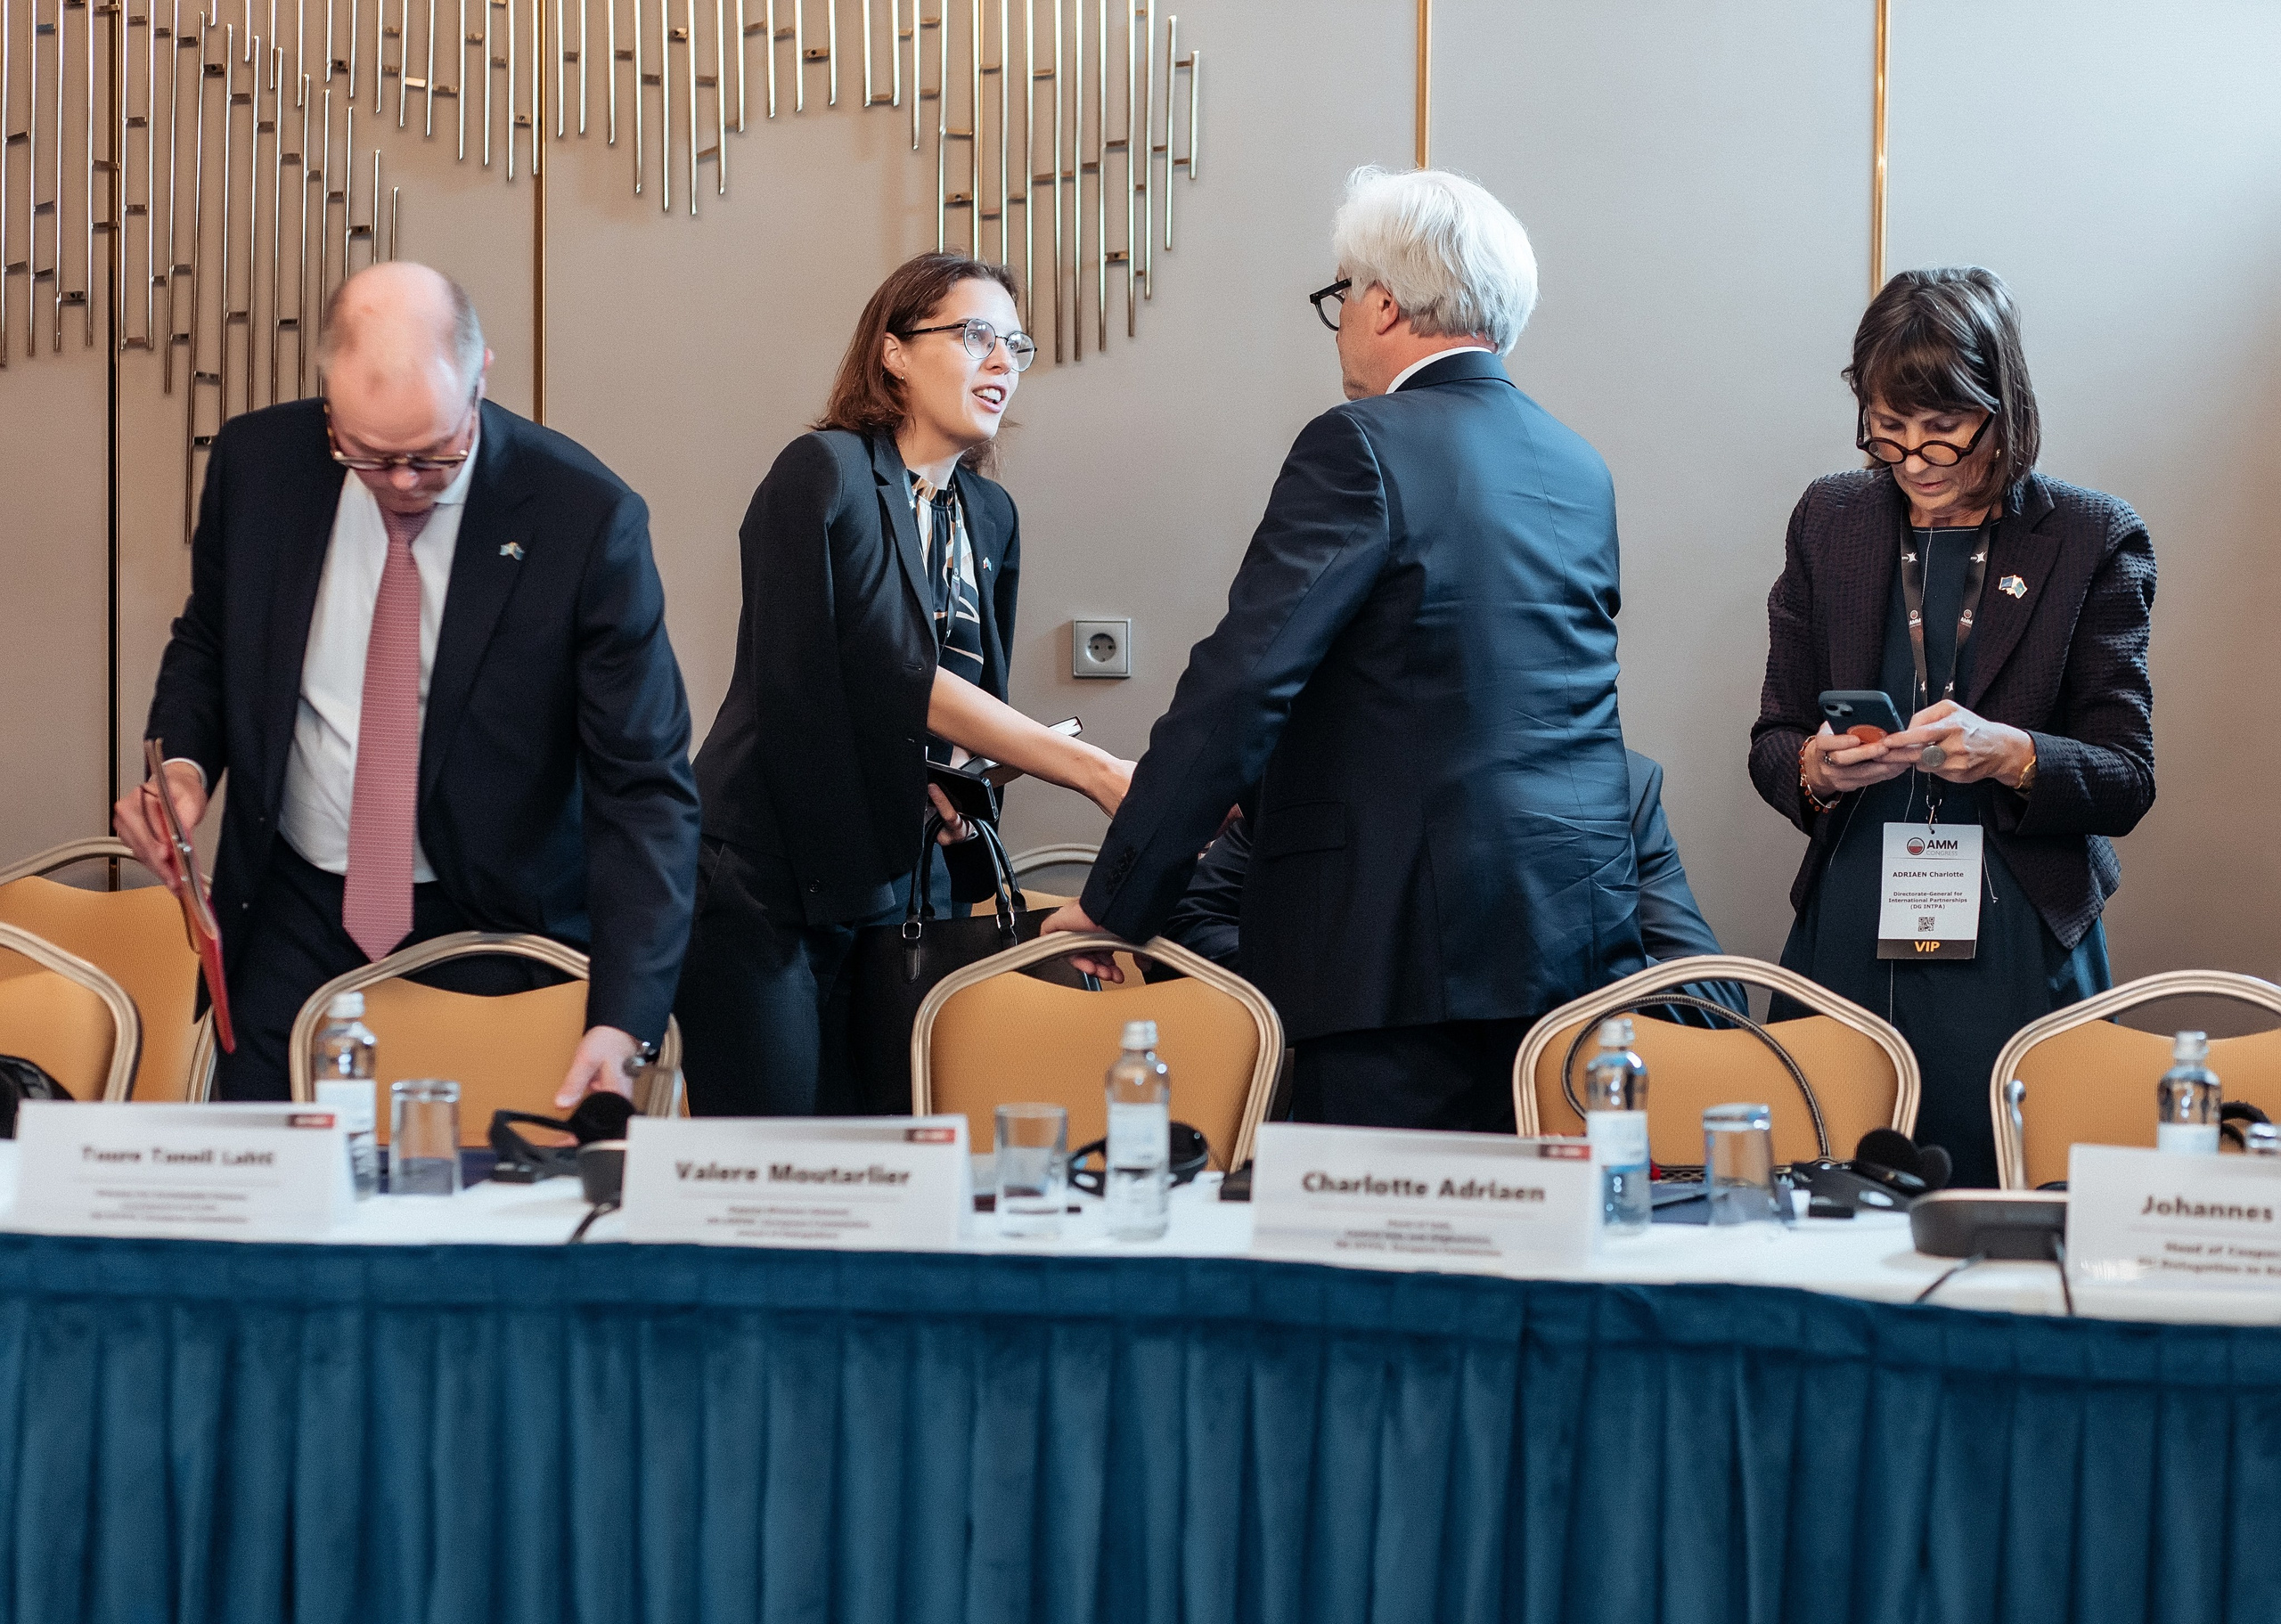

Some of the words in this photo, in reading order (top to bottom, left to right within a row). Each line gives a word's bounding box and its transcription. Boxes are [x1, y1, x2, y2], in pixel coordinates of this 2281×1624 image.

[1926, 839, 1958, 850] AMM
[1915, 941, 1941, 952] VIP
[1302, 1171, 1427, 1197] Charlotte
[1437, 1178, 1547, 1203] Adriaen
[2141, 1194, 2274, 1223] Johannes
